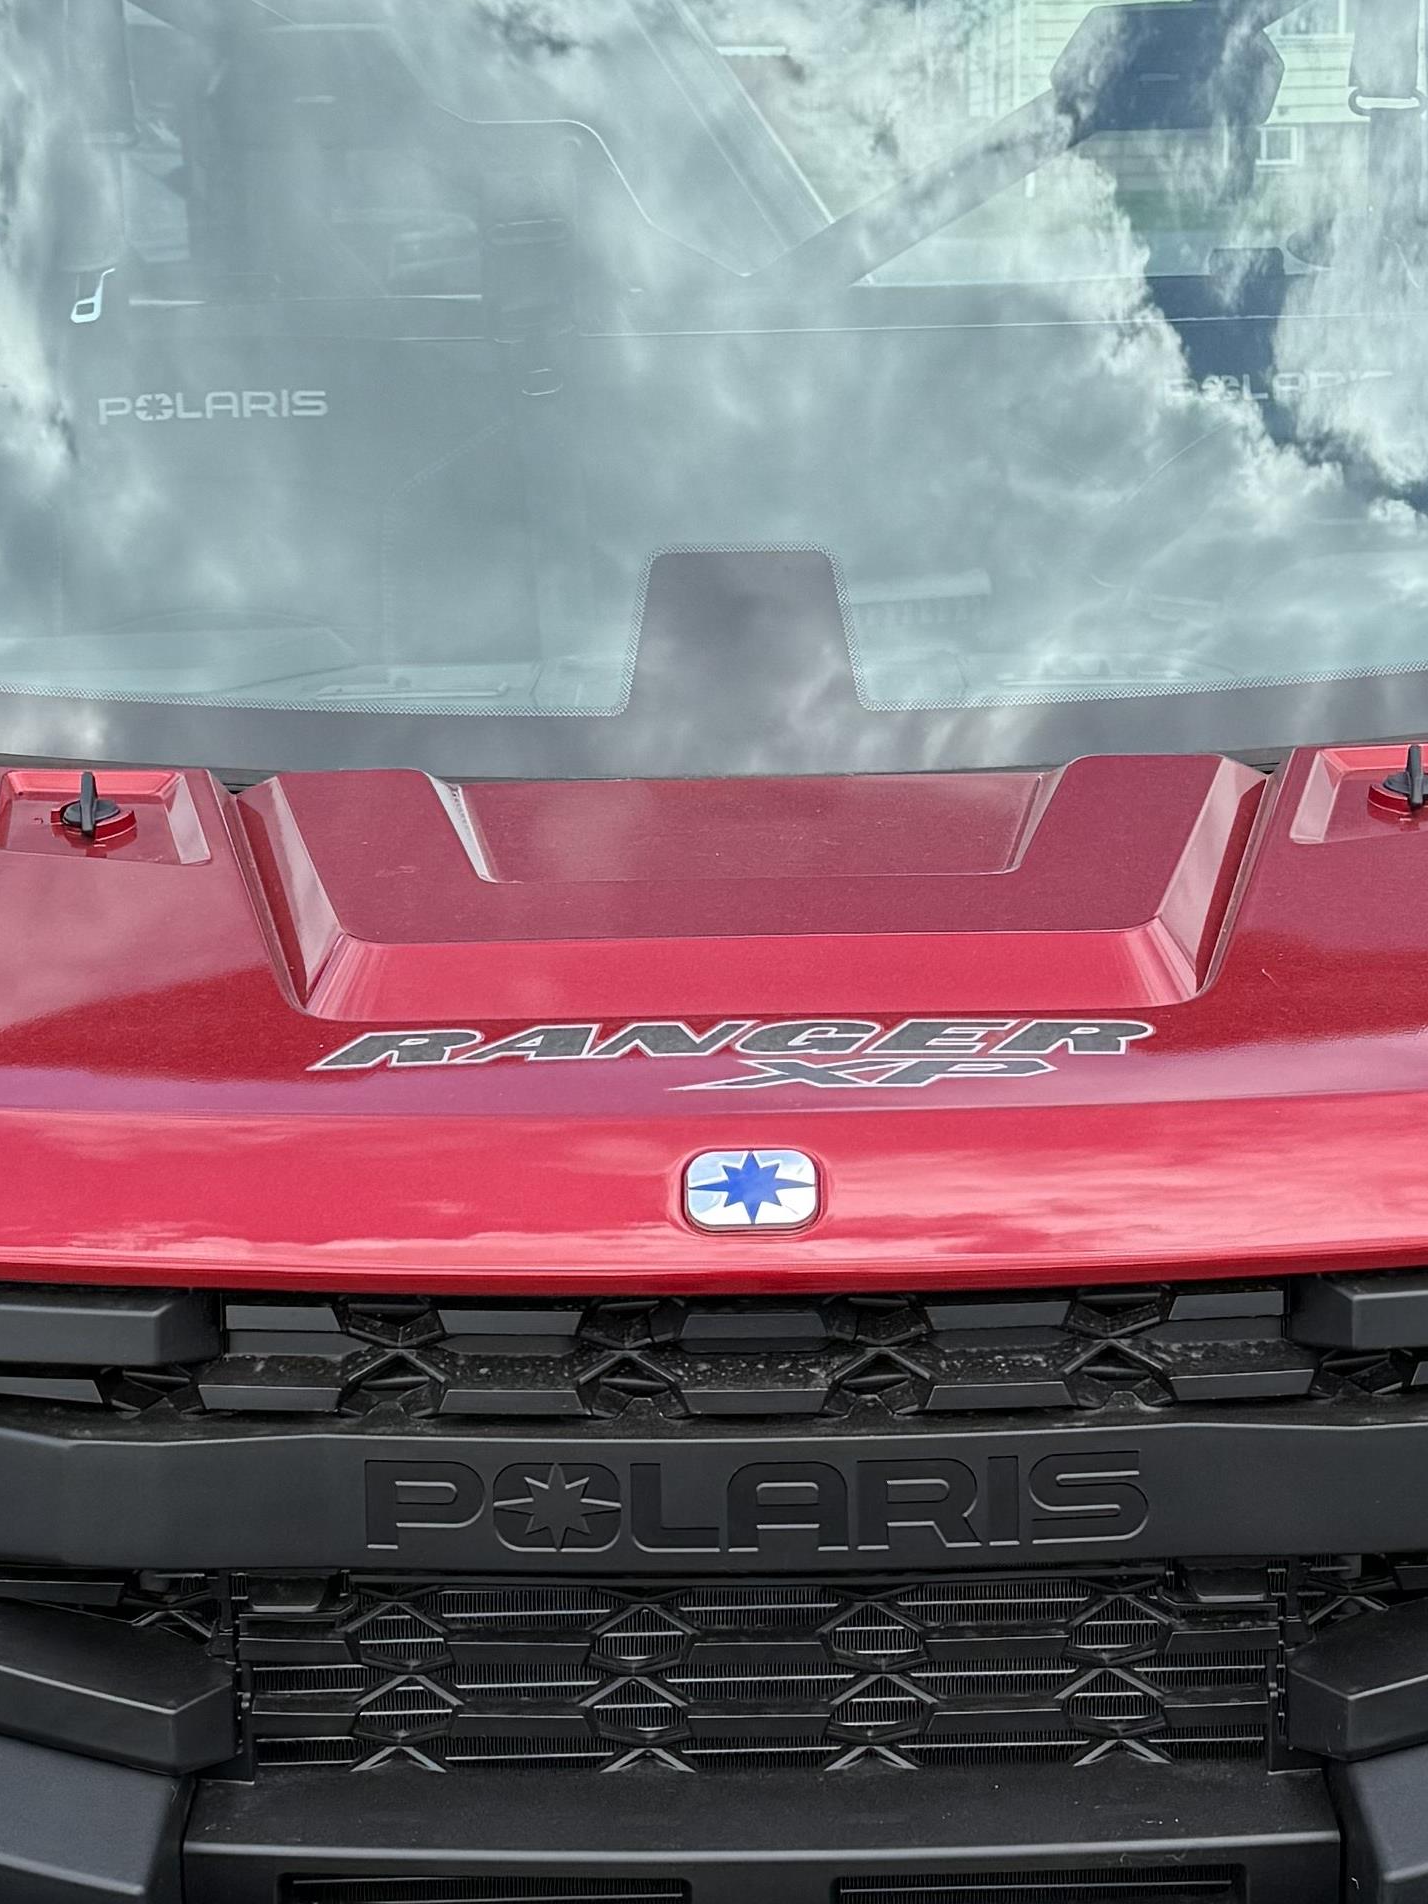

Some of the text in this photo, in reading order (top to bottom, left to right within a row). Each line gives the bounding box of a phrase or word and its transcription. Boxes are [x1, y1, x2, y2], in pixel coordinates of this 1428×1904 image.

[1164, 370, 1393, 405] POLAR
[98, 389, 329, 425] POLARIS
[306, 1018, 1156, 1071] RANGER
[665, 1057, 1059, 1092] XP
[365, 1450, 1149, 1553] POLARIS
